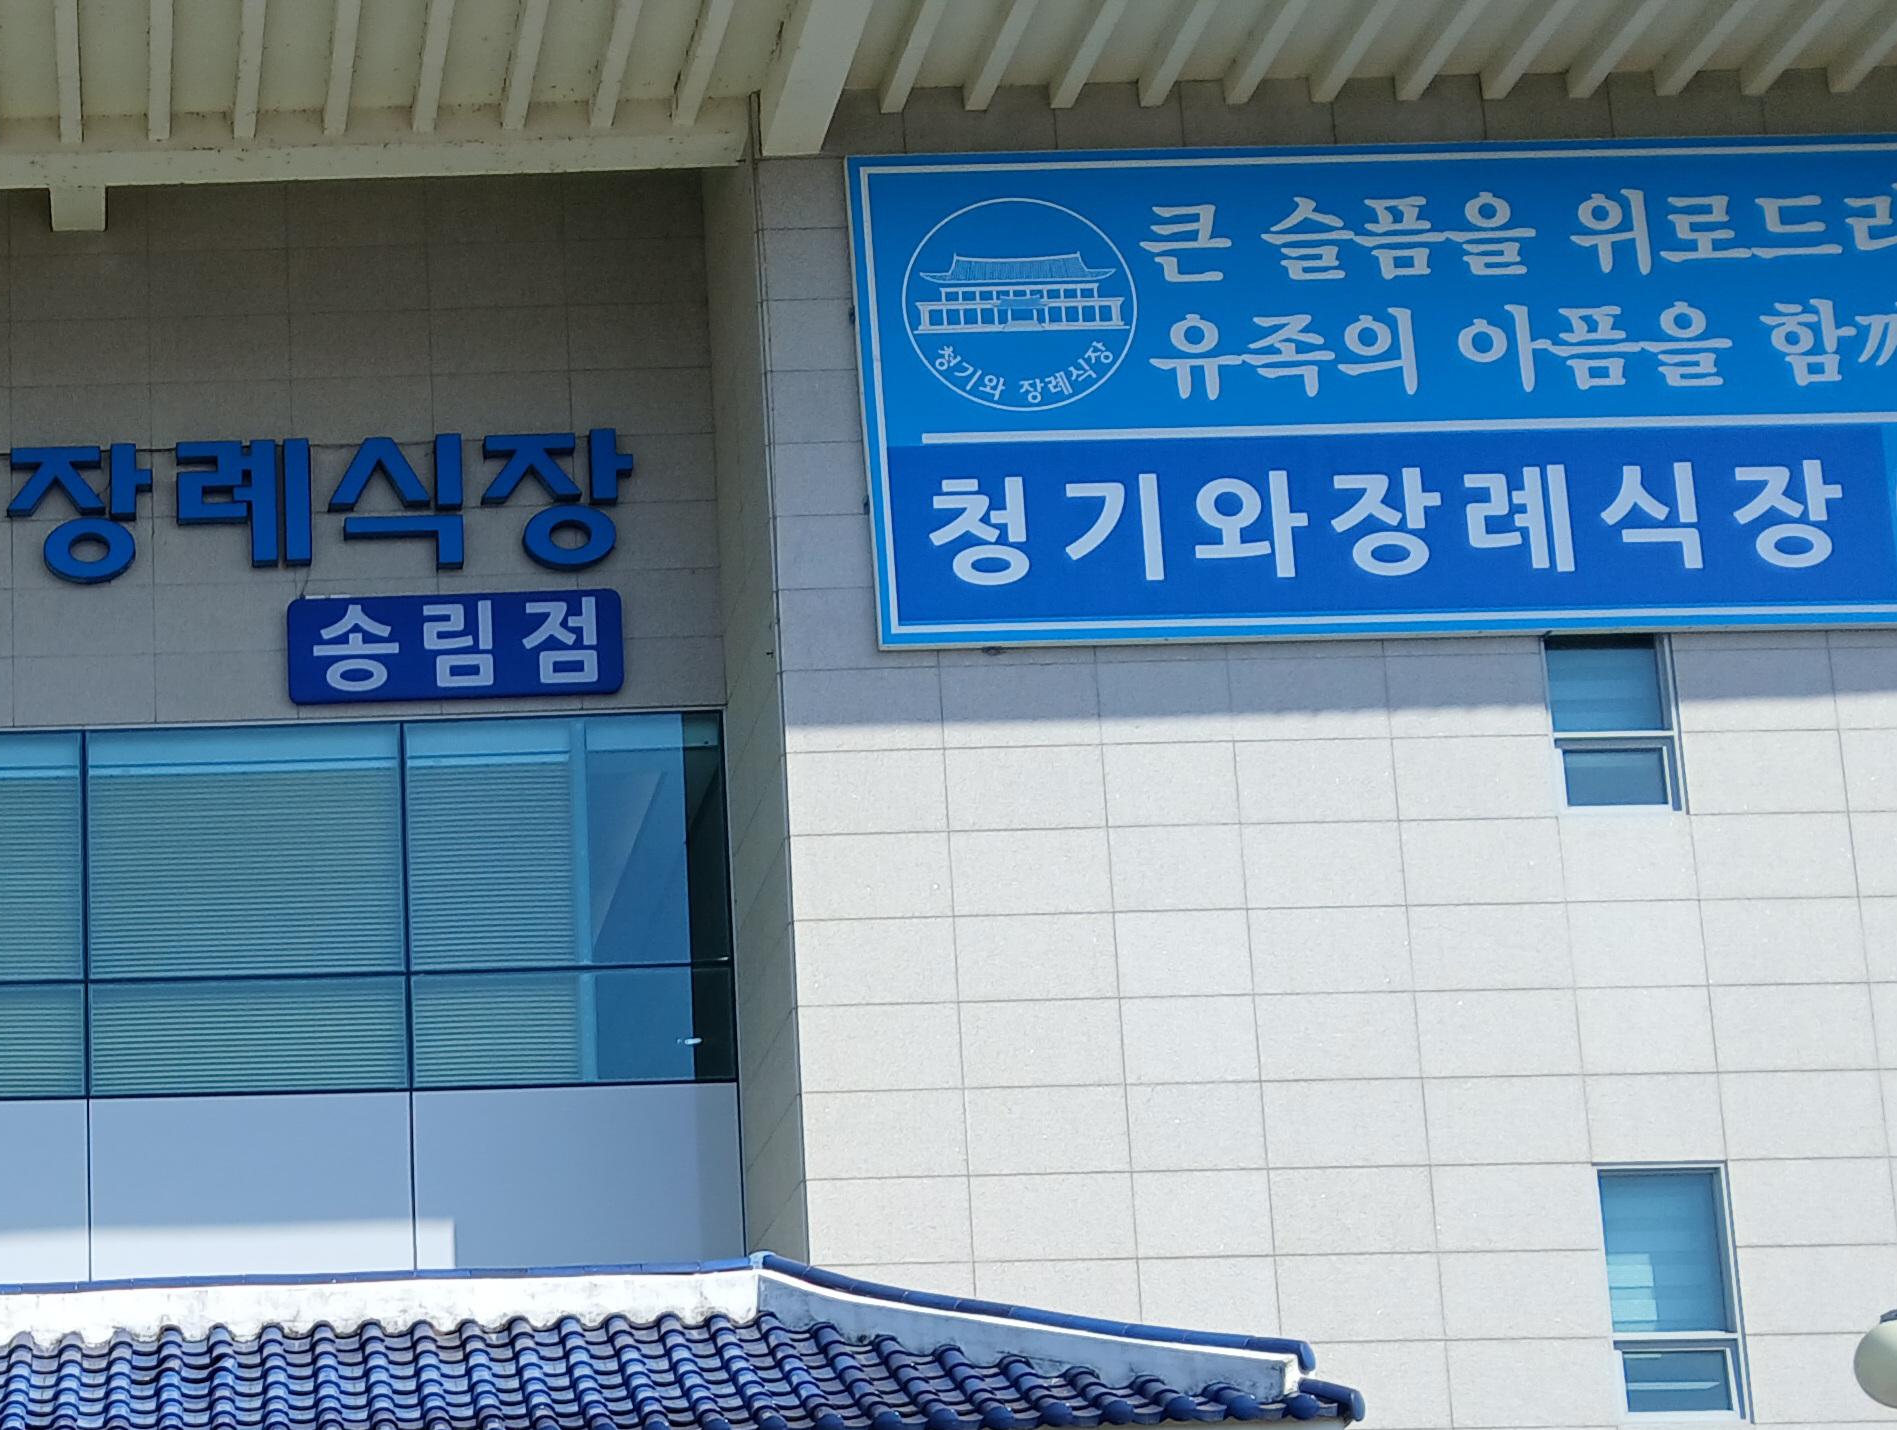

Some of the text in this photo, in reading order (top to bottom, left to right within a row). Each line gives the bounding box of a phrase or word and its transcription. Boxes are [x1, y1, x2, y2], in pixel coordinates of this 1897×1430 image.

[1139, 202, 1232, 283] 큰
[1260, 191, 1537, 281] 슬픔을
[935, 340, 1113, 404] 청기와 장례식장
[1149, 307, 1419, 401] 유족의
[1459, 300, 1733, 392] 아픔을
[929, 458, 1843, 587] 청기와장례식장
[312, 597, 599, 691] 송림점
